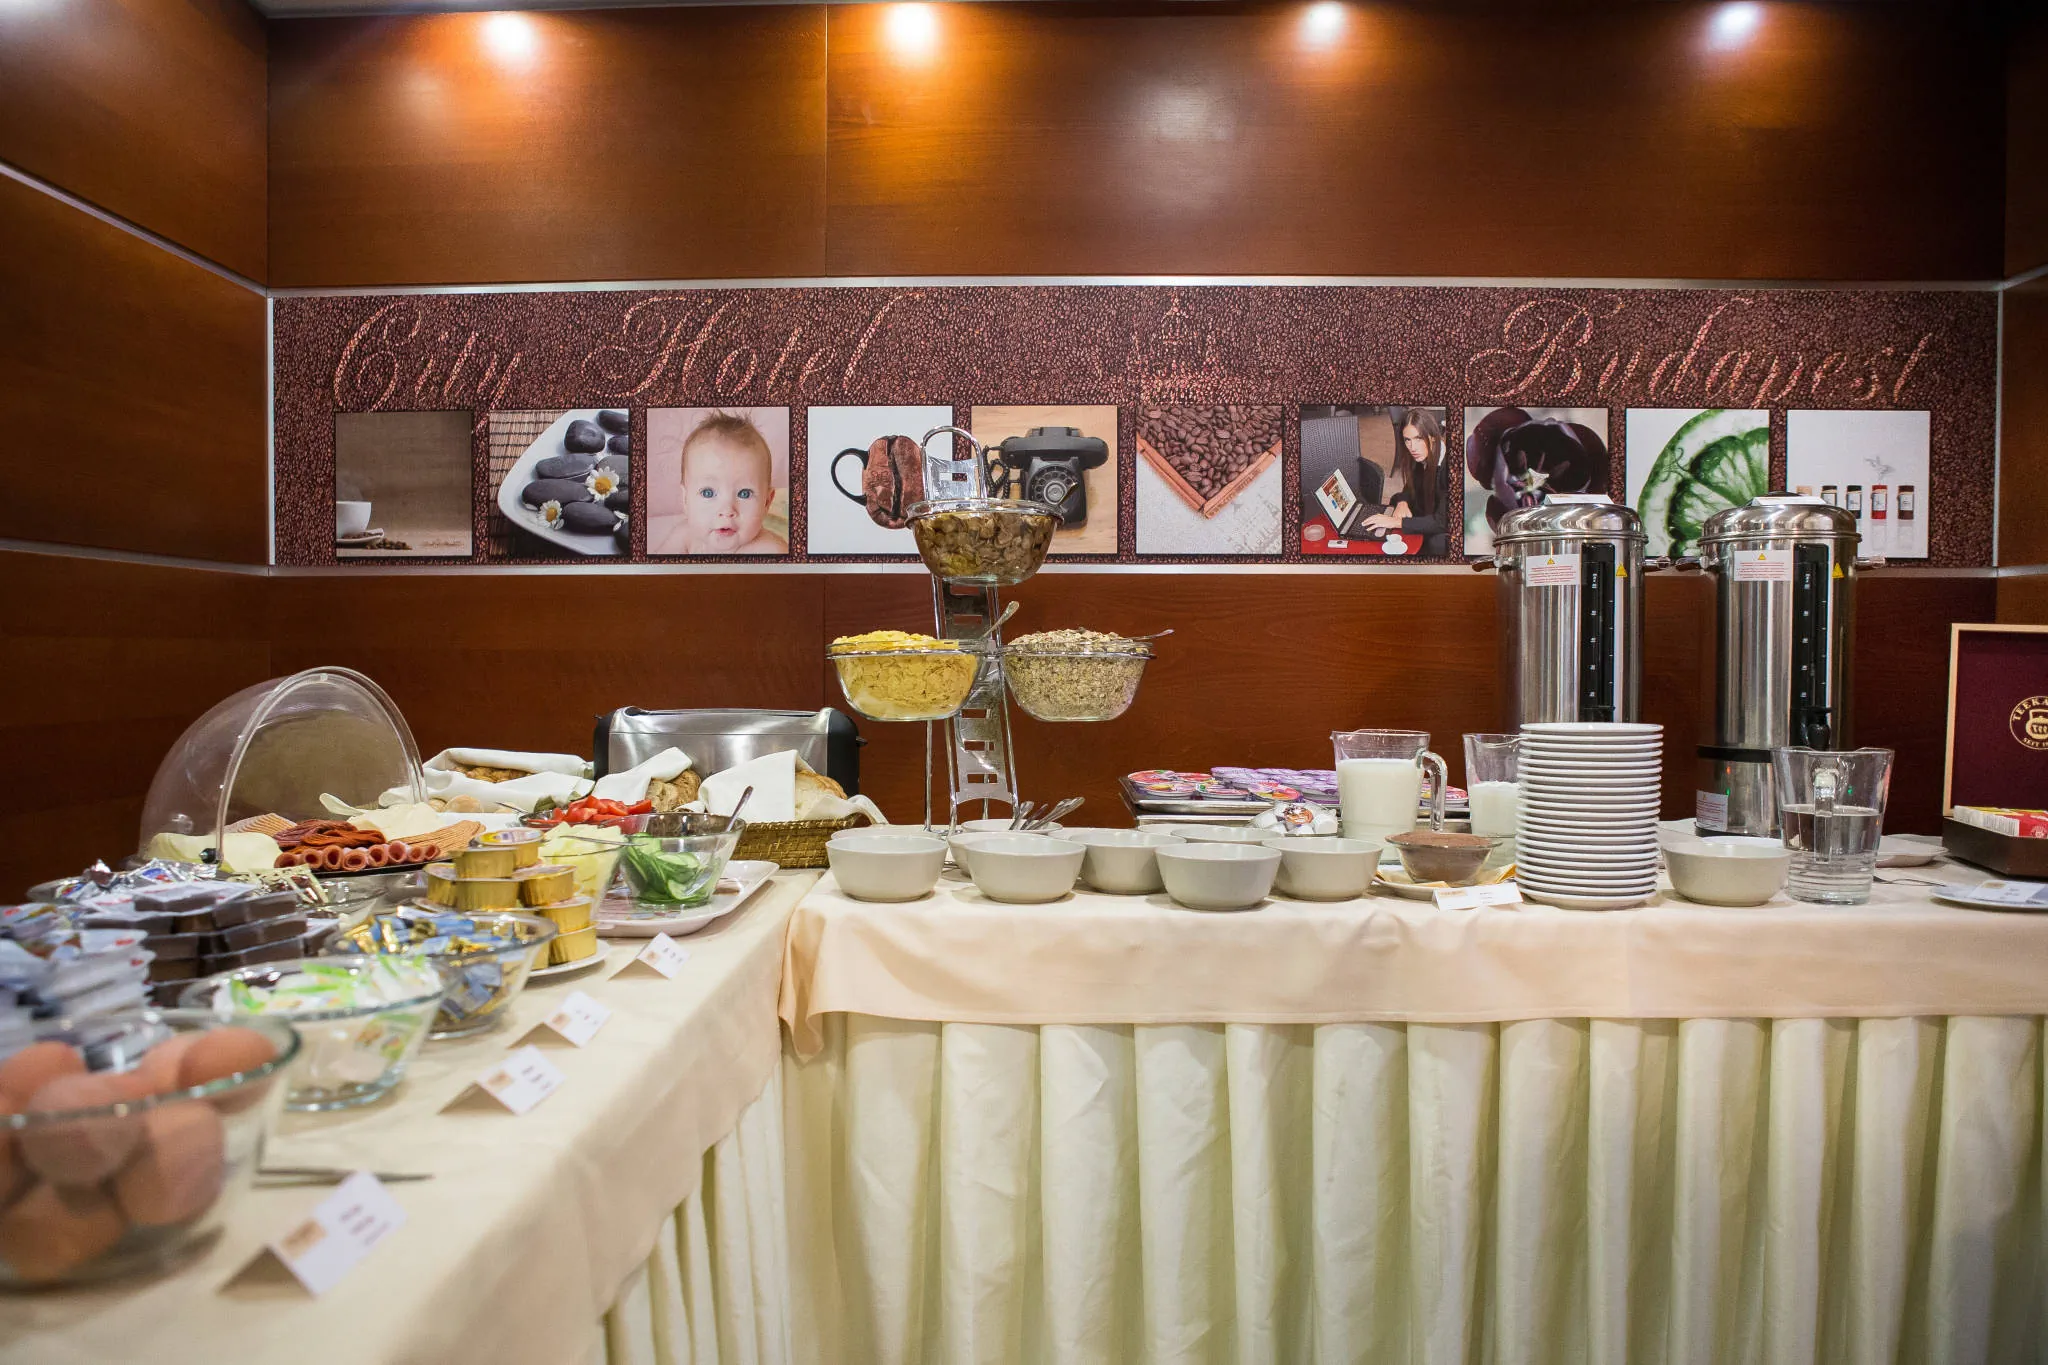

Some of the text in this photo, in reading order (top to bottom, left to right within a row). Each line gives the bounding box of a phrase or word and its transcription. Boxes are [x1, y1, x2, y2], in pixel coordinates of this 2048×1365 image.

[333, 290, 1932, 436] City Hotel Budapest
